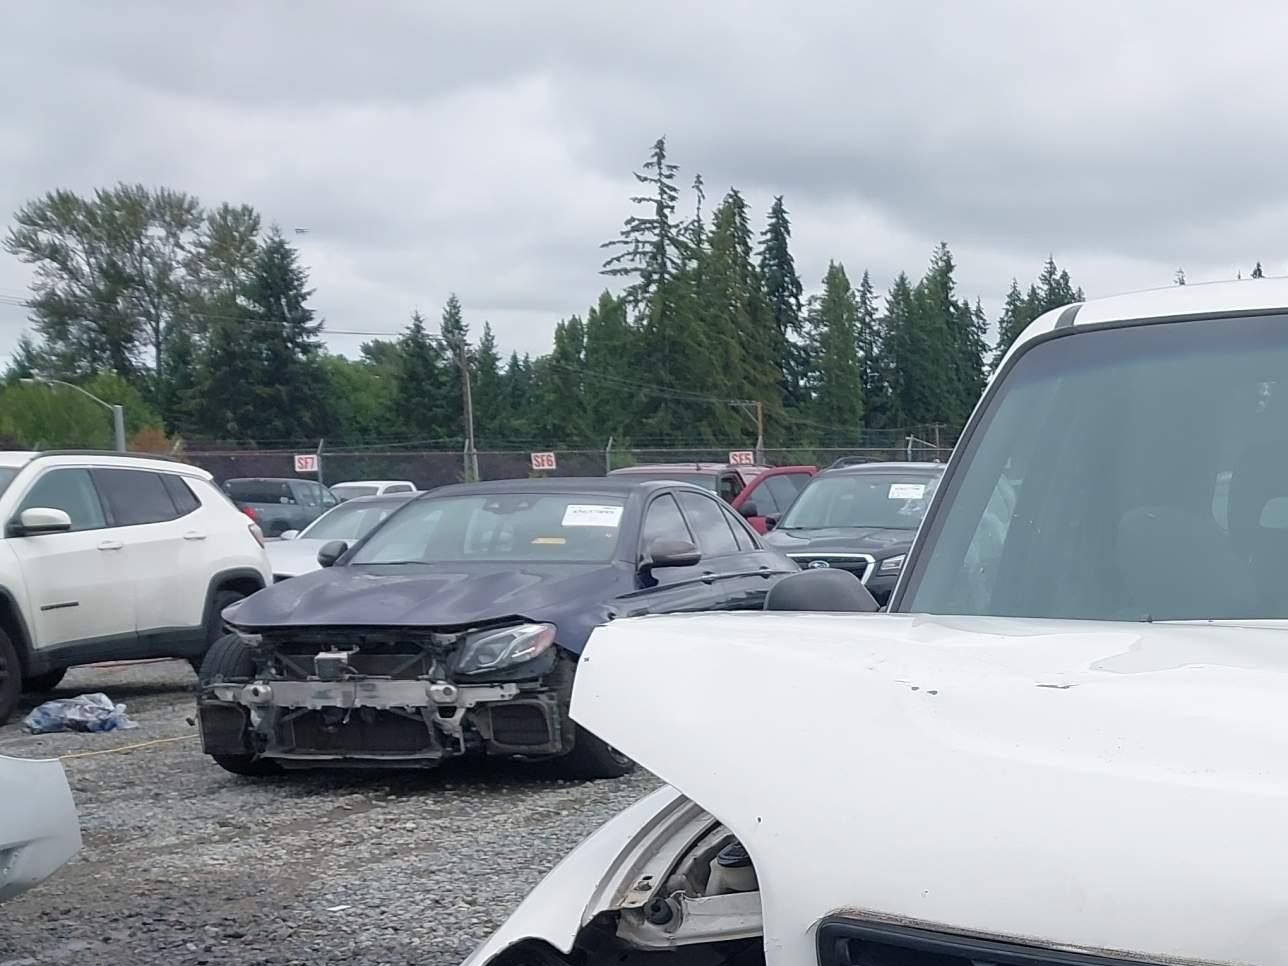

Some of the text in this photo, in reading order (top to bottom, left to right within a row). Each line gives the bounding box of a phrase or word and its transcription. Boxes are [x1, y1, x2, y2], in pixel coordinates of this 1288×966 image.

[297, 456, 315, 470] SF7
[534, 454, 554, 468] SF6
[731, 452, 752, 465] SF5
